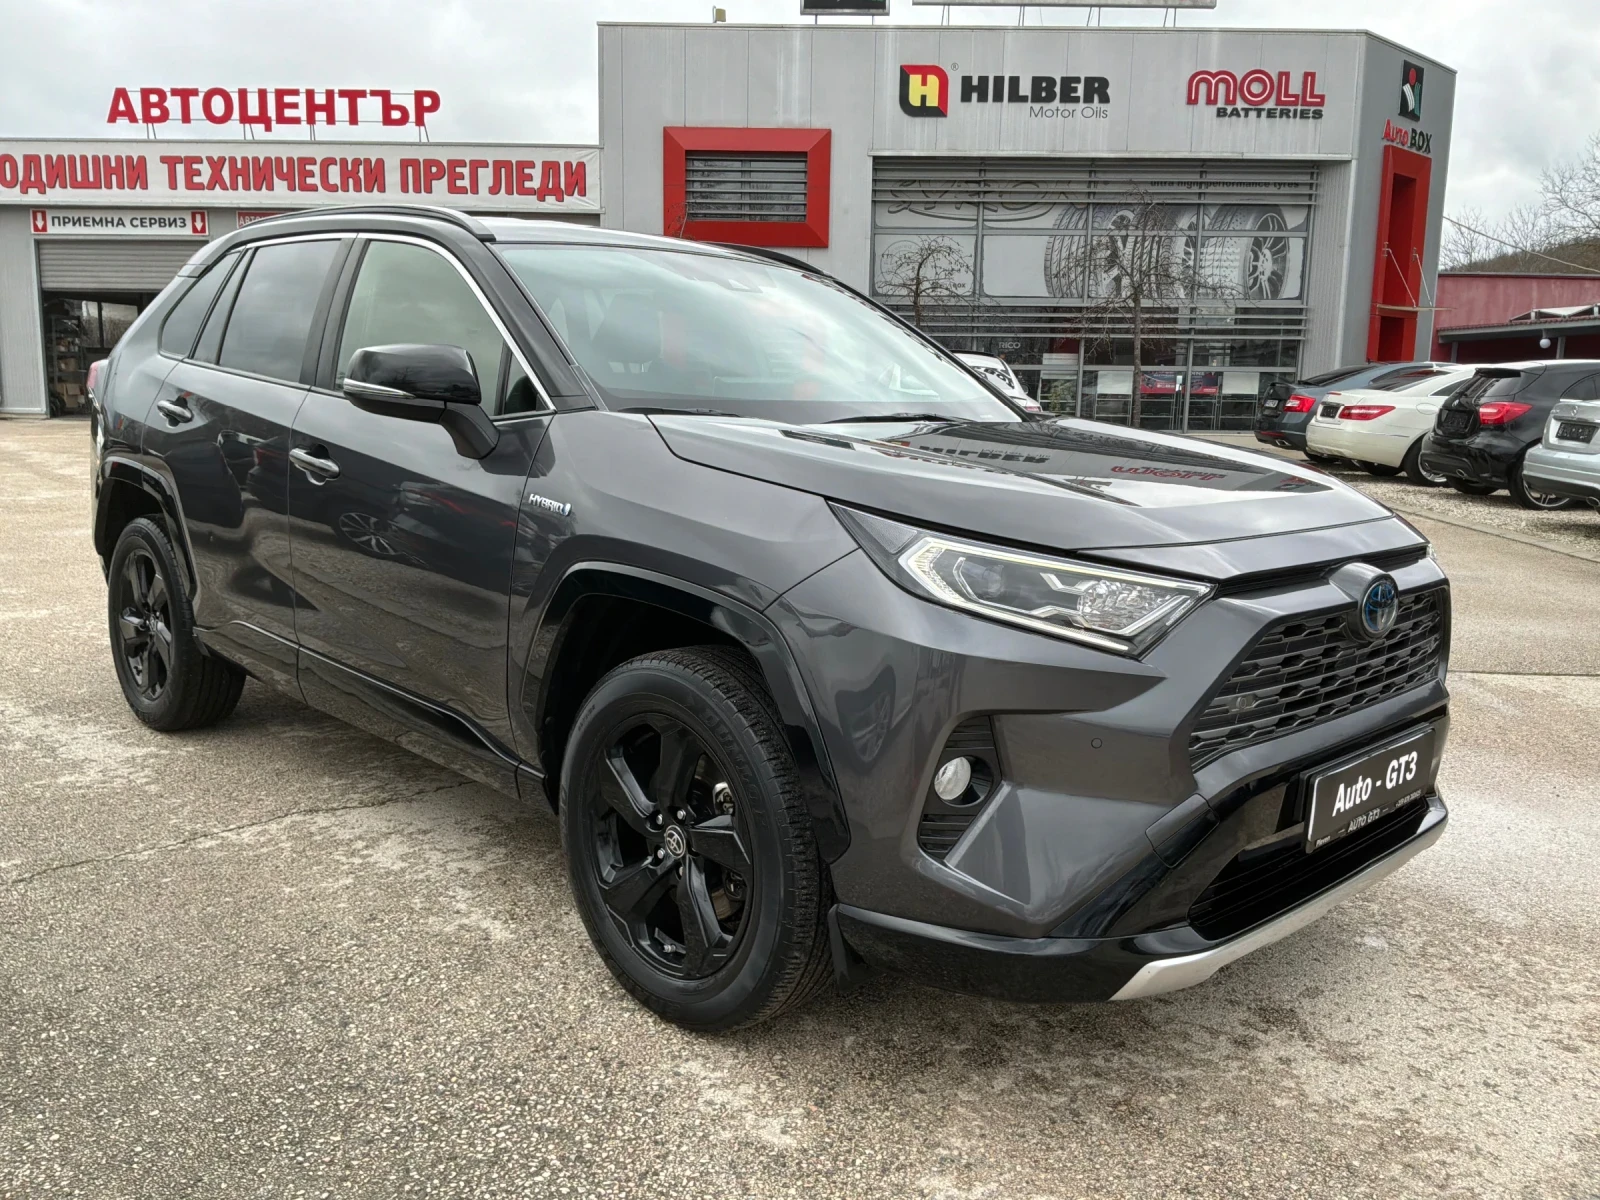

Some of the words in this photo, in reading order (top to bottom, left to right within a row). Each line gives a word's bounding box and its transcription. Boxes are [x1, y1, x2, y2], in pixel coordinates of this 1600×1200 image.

[960, 75, 1111, 104] HILBER
[1186, 69, 1326, 107] MOLL
[106, 86, 442, 133] АВТОЦЕНТЪР
[1029, 106, 1076, 119] Motor
[1080, 106, 1109, 119] Oils
[1215, 107, 1324, 120] BATTERIES
[159, 154, 387, 194] ТЕХНИЧЕСКИ
[399, 157, 587, 202] ПРЕГЛЕДИ
[51, 214, 126, 228] ПРИЕМНА
[129, 216, 188, 229] СЕРВИЗ
[528, 493, 565, 514] HYBRID
[1332, 775, 1373, 818] Auto
[1385, 751, 1418, 790] GT3
